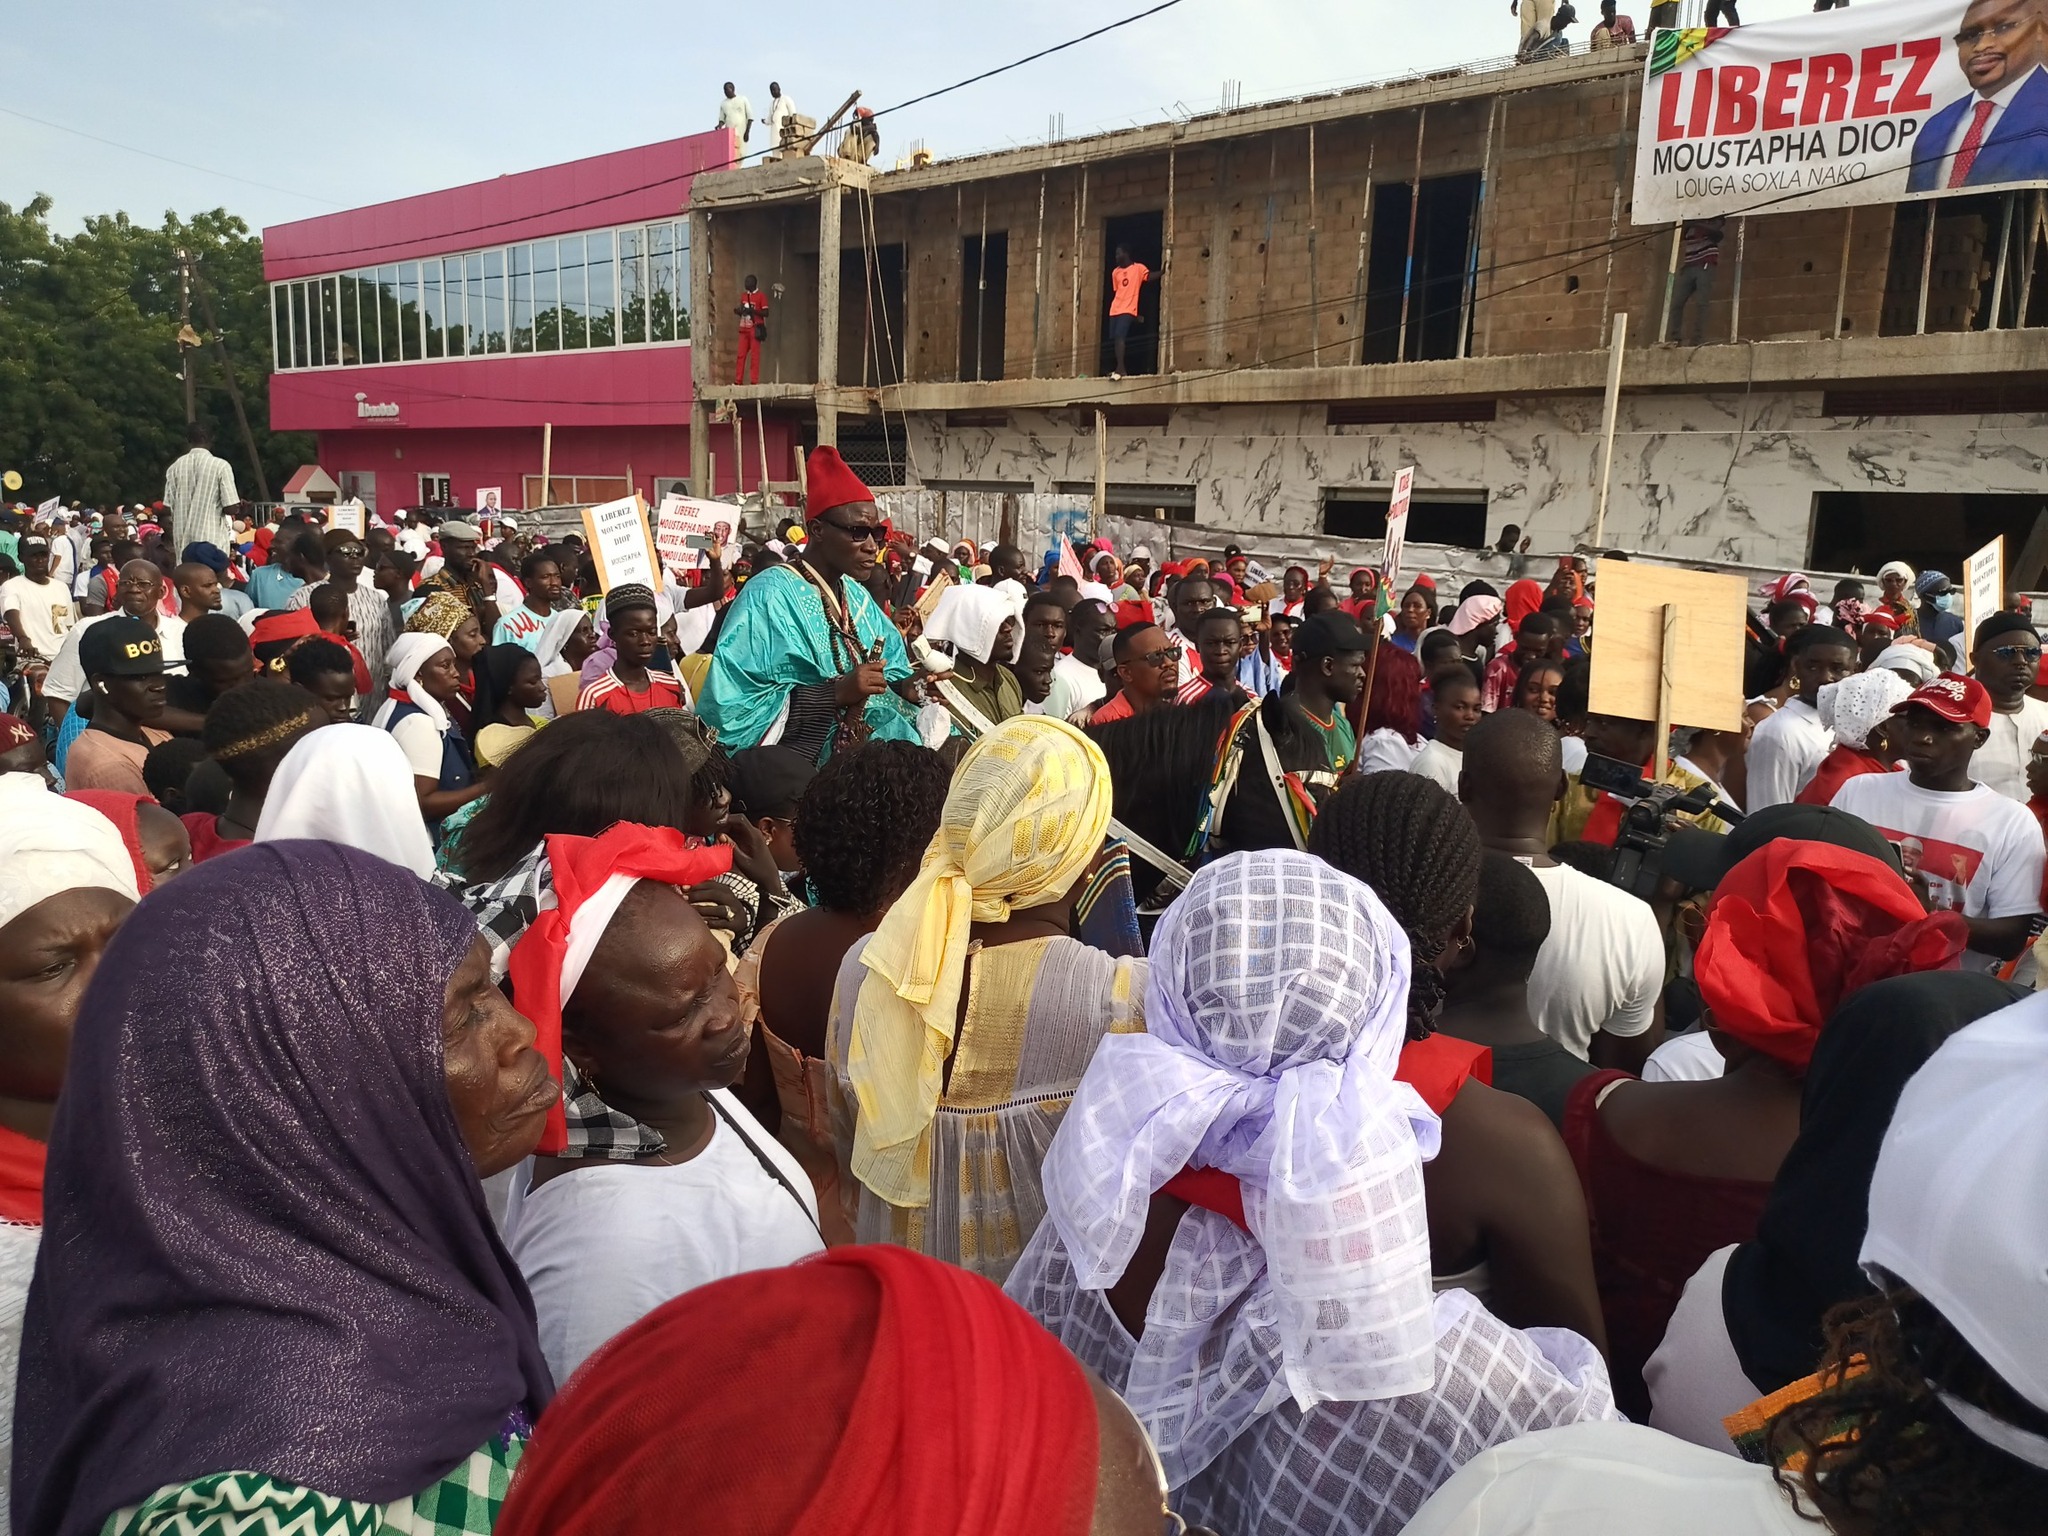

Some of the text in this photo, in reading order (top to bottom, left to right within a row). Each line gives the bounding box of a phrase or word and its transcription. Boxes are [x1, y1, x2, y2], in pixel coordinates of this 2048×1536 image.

[1657, 37, 1941, 142] LIBEREZ
[1653, 118, 1917, 176] MOUSTAPHA DIOP
[1675, 162, 1867, 200] LOUGA SOXLA NAKO
[600, 506, 632, 522] LIBEREZ
[674, 504, 700, 518] LIBEREZ
[601, 519, 638, 535] MOUSTAPHA
[658, 518, 698, 533] MOUSTAPHA
[613, 533, 631, 546] DIOP
[658, 534, 680, 546] NOTRE
[1974, 552, 1995, 573] LIBEREZ
